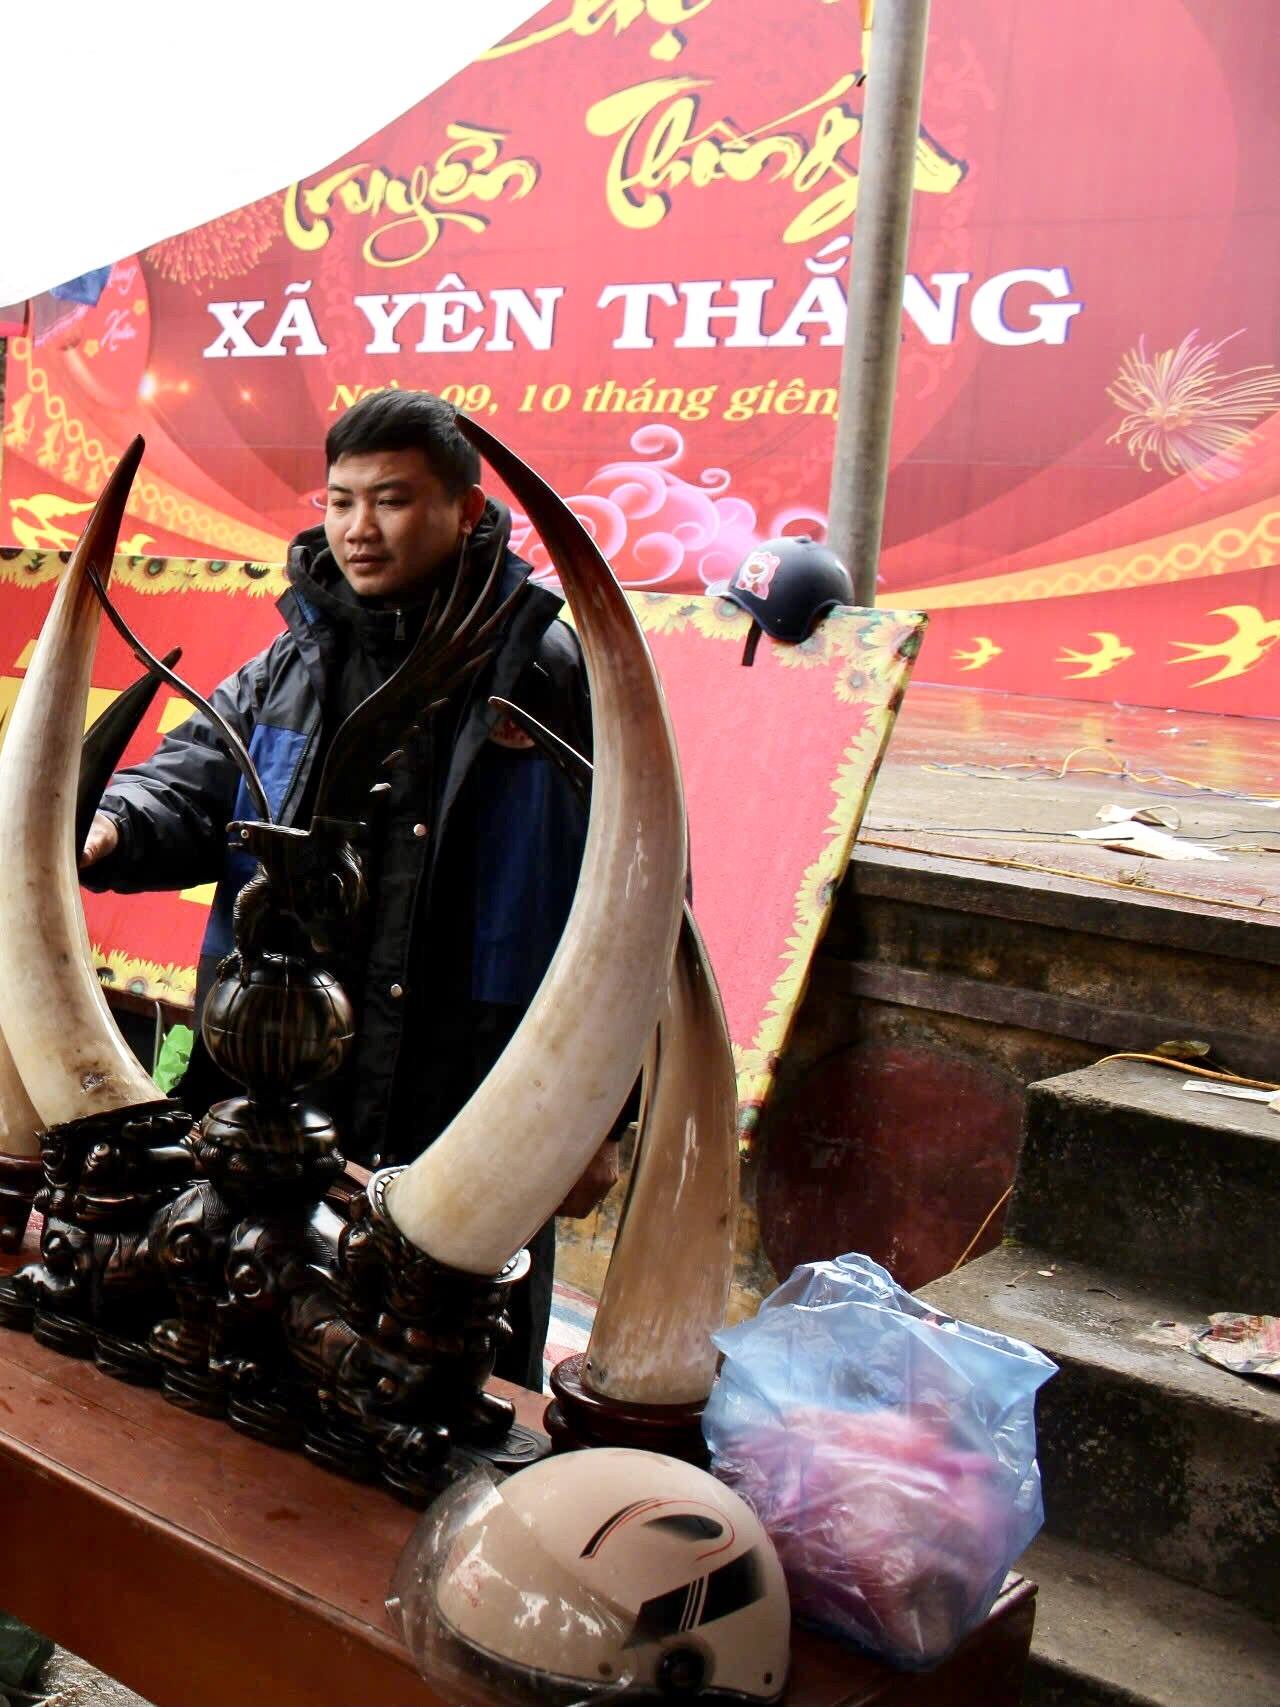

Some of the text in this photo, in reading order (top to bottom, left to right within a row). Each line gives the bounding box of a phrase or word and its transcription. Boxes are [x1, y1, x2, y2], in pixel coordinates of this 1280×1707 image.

[203, 235, 1083, 358] XÃ YÊN THẮNG
[518, 383, 572, 412] 10
[582, 377, 718, 421] tháng
[722, 377, 839, 421] giên
